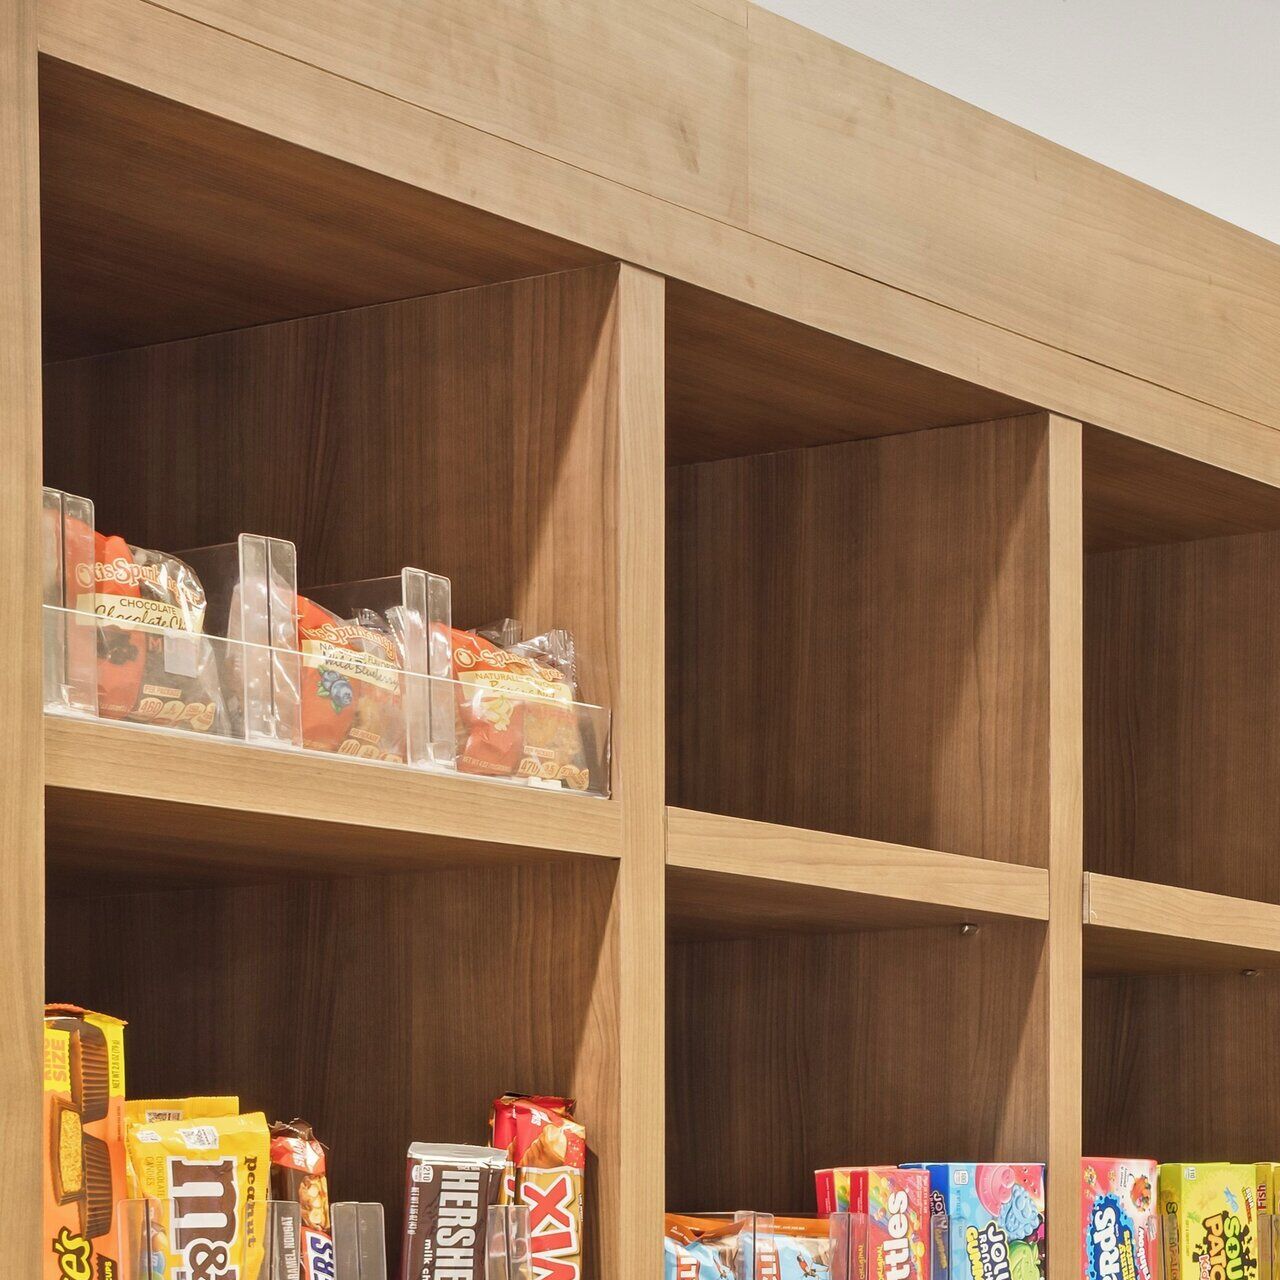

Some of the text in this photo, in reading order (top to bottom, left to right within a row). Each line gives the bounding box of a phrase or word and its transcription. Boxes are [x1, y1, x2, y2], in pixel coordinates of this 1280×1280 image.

[120, 598, 177, 616] CHOCOLATE
[52, 1038, 67, 1082] SIZE
[243, 1155, 258, 1249] peanut
[1256, 1183, 1267, 1211] Fish
[423, 1239, 432, 1266] milk
